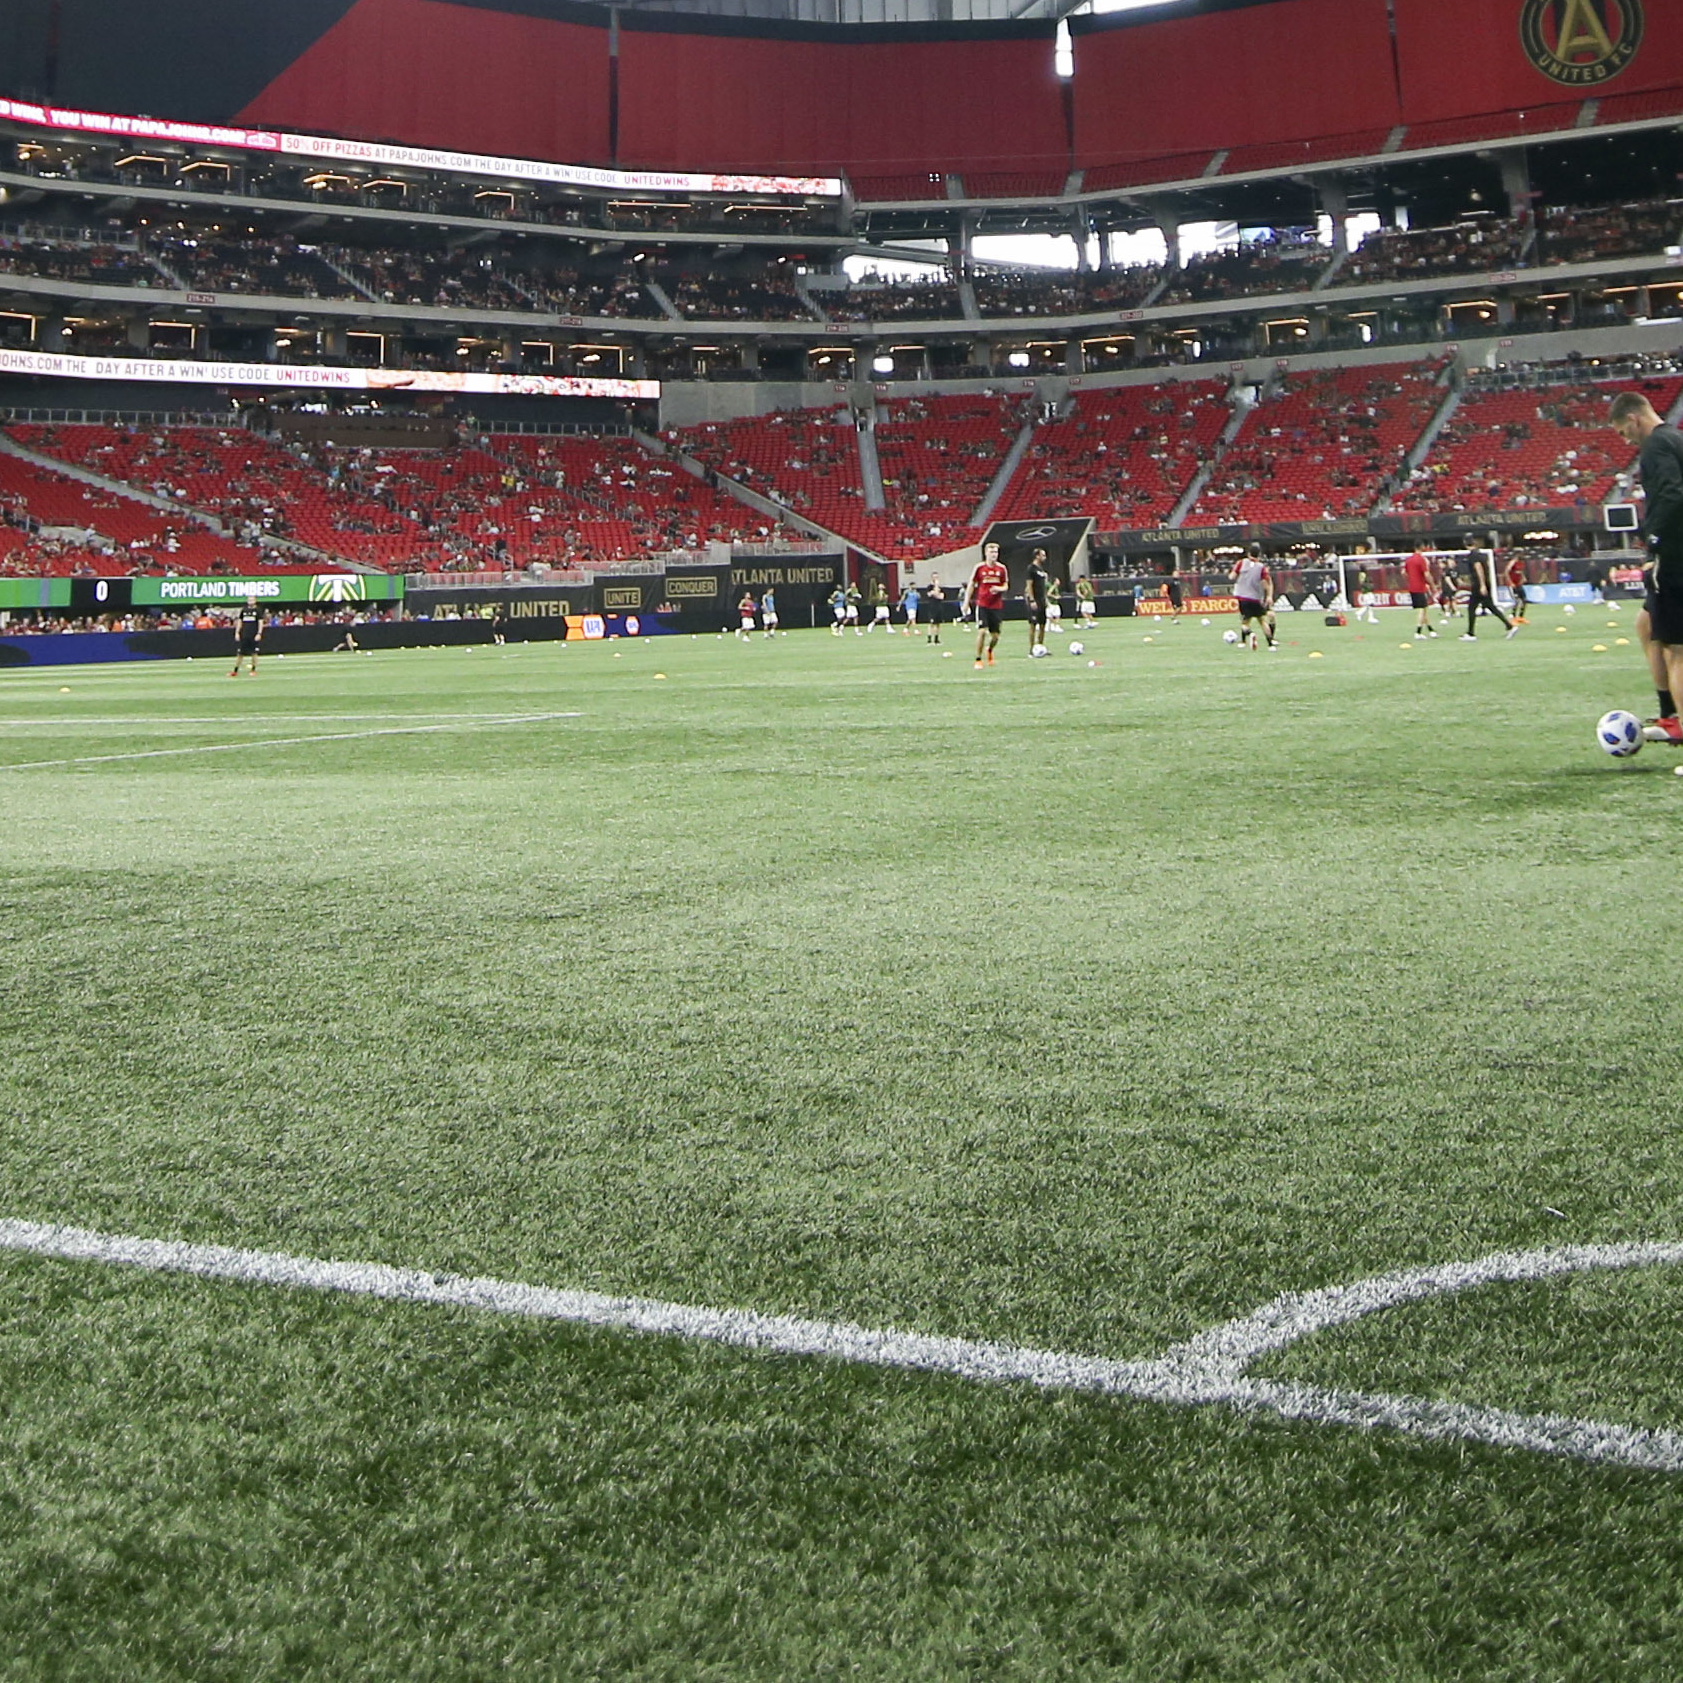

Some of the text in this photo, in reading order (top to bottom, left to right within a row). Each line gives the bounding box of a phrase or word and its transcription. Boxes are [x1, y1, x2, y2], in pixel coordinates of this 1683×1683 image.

[1537, 43, 1634, 82] UNITED FC
[49, 109, 80, 126] YOU
[80, 113, 111, 130] WIN
[110, 117, 131, 132] AT
[312, 140, 331, 153] OFF
[335, 142, 372, 158] PIZZAS
[374, 148, 386, 159] AT
[474, 158, 493, 171] THE
[494, 160, 512, 173] DAY
[514, 162, 544, 176] AFTER
[574, 170, 592, 181] USE
[623, 175, 691, 187] UNITEDWINS
[66, 359, 87, 373] THE
[95, 362, 122, 376] DAY
[124, 363, 165, 377] AFTER
[167, 365, 176, 377] A
[211, 366, 235, 380] USE
[276, 369, 351, 384] UNITEDWINS
[1141, 527, 1219, 543] ATLANTA UNITED
[787, 567, 834, 583] UNITED
[95, 581, 109, 602] 0
[160, 579, 281, 600] PORTLAND TIMBERS
[669, 578, 716, 596] CONQUER
[1558, 586, 1586, 599] AT&T
[608, 590, 639, 607] UNITE
[510, 600, 570, 618] UNITED
